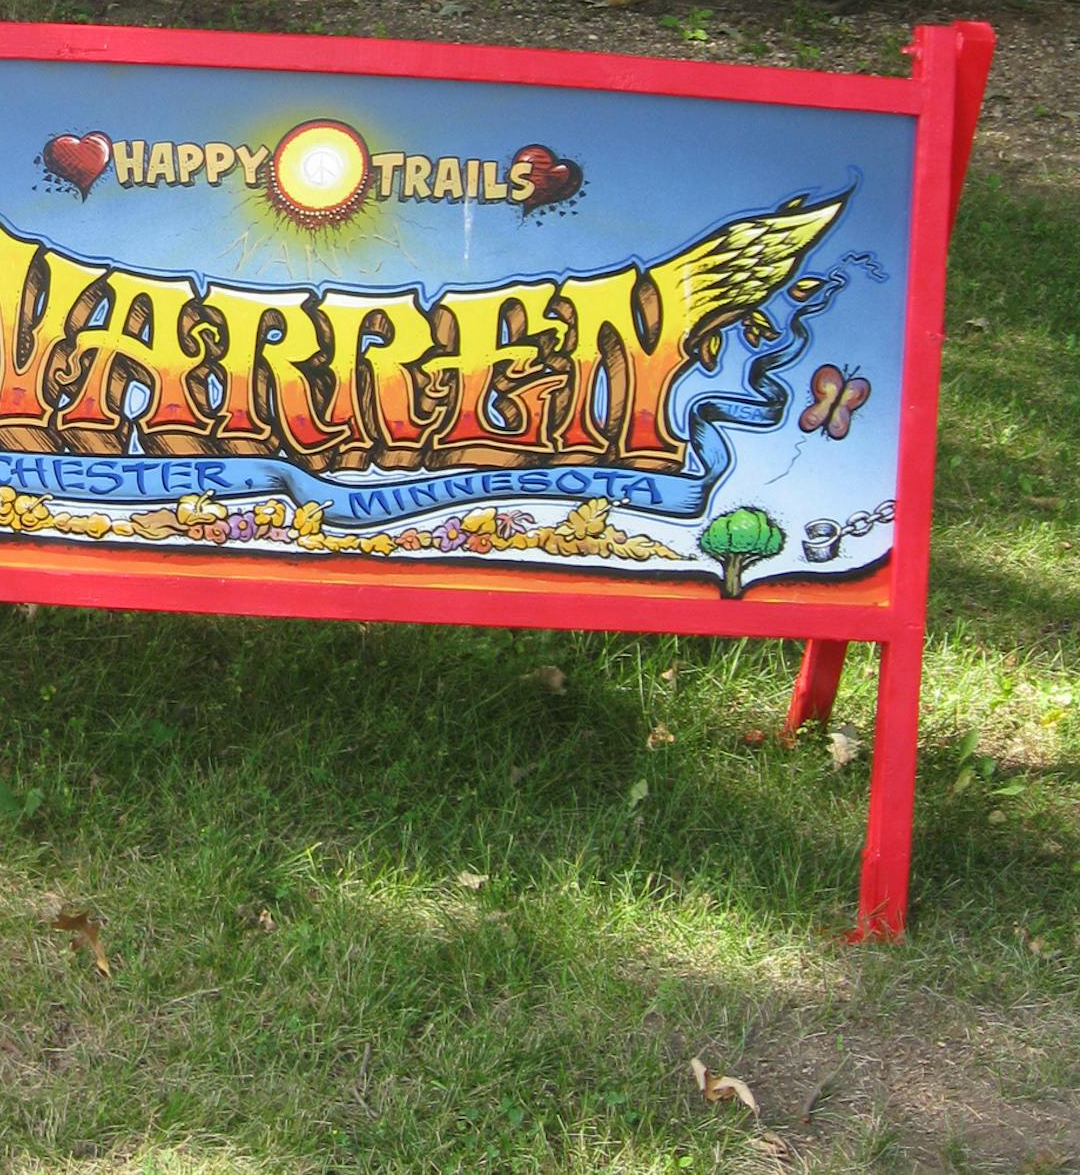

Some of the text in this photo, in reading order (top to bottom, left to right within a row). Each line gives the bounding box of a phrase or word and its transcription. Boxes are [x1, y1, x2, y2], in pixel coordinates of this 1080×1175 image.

[111, 139, 536, 205] HAPPY TRAILS
[216, 220, 420, 280] NANCY
[728, 403, 766, 420] USA
[349, 470, 664, 518] MINNESOTA
